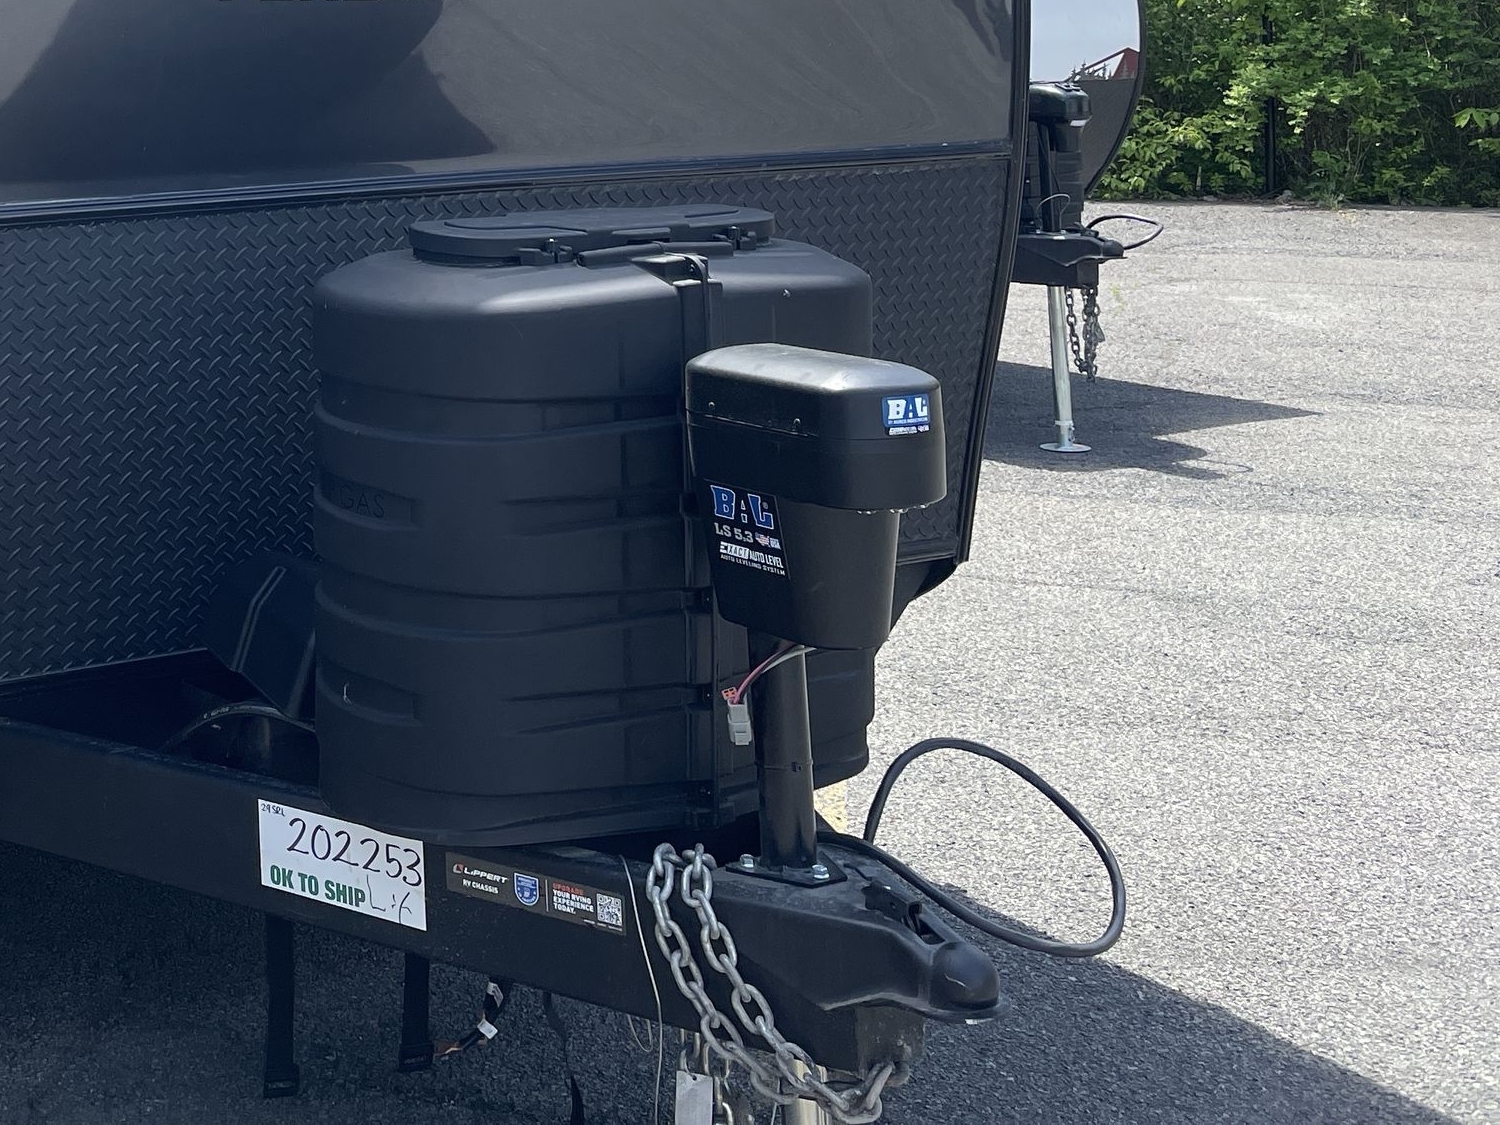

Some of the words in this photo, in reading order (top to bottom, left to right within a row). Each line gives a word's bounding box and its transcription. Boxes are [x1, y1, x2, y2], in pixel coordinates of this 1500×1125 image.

[340, 483, 385, 518] GAS
[714, 522, 731, 537] LS
[720, 541, 749, 559] EXACT
[749, 550, 765, 563] AUTO
[765, 554, 784, 568] LEVEL
[286, 817, 422, 887] 202253
[463, 866, 509, 883] LIPPERT
[270, 864, 294, 890] OK
[298, 872, 319, 896] TO
[324, 879, 366, 908] SHIP
[462, 878, 471, 888] RV
[471, 880, 499, 894] CHASSIS
[553, 889, 571, 900] YOUR
[571, 893, 592, 905] RVING
[553, 895, 594, 913] EXPERIENCE
